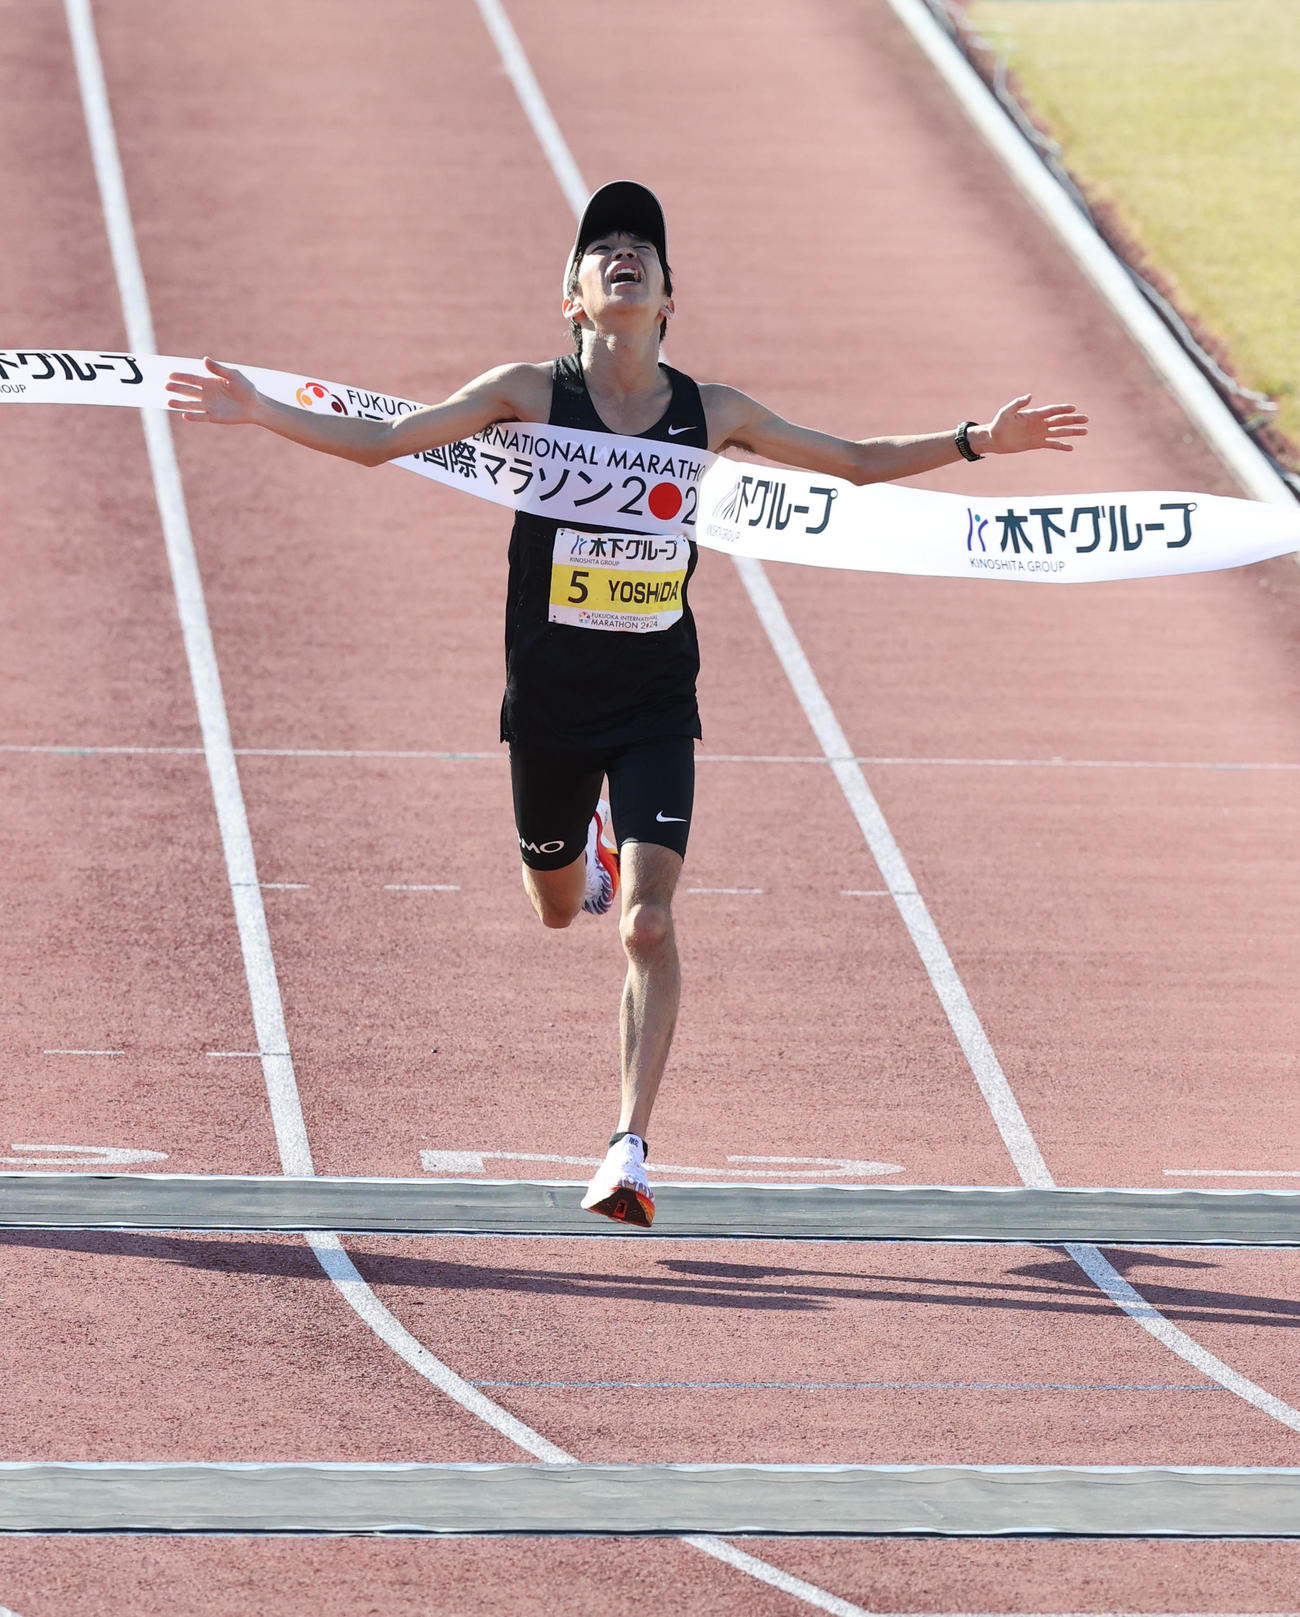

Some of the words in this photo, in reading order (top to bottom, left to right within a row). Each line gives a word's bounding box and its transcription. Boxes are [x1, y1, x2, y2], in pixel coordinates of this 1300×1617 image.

[0, 384, 27, 394] OUP
[346, 389, 424, 416] FUKUO
[995, 502, 1198, 555] 木下グループ
[588, 537, 678, 561] 木下グループ
[569, 556, 599, 565] KINOSHITA
[600, 559, 620, 567] GROUP
[970, 557, 1024, 572] KINOSHITA
[1027, 560, 1066, 573] GROUP
[567, 570, 590, 604] 5
[608, 579, 680, 605] YOSHIDA
[590, 618, 638, 629] MARATHON
[591, 612, 619, 620] FUKUOKA
[518, 833, 565, 854] MO
